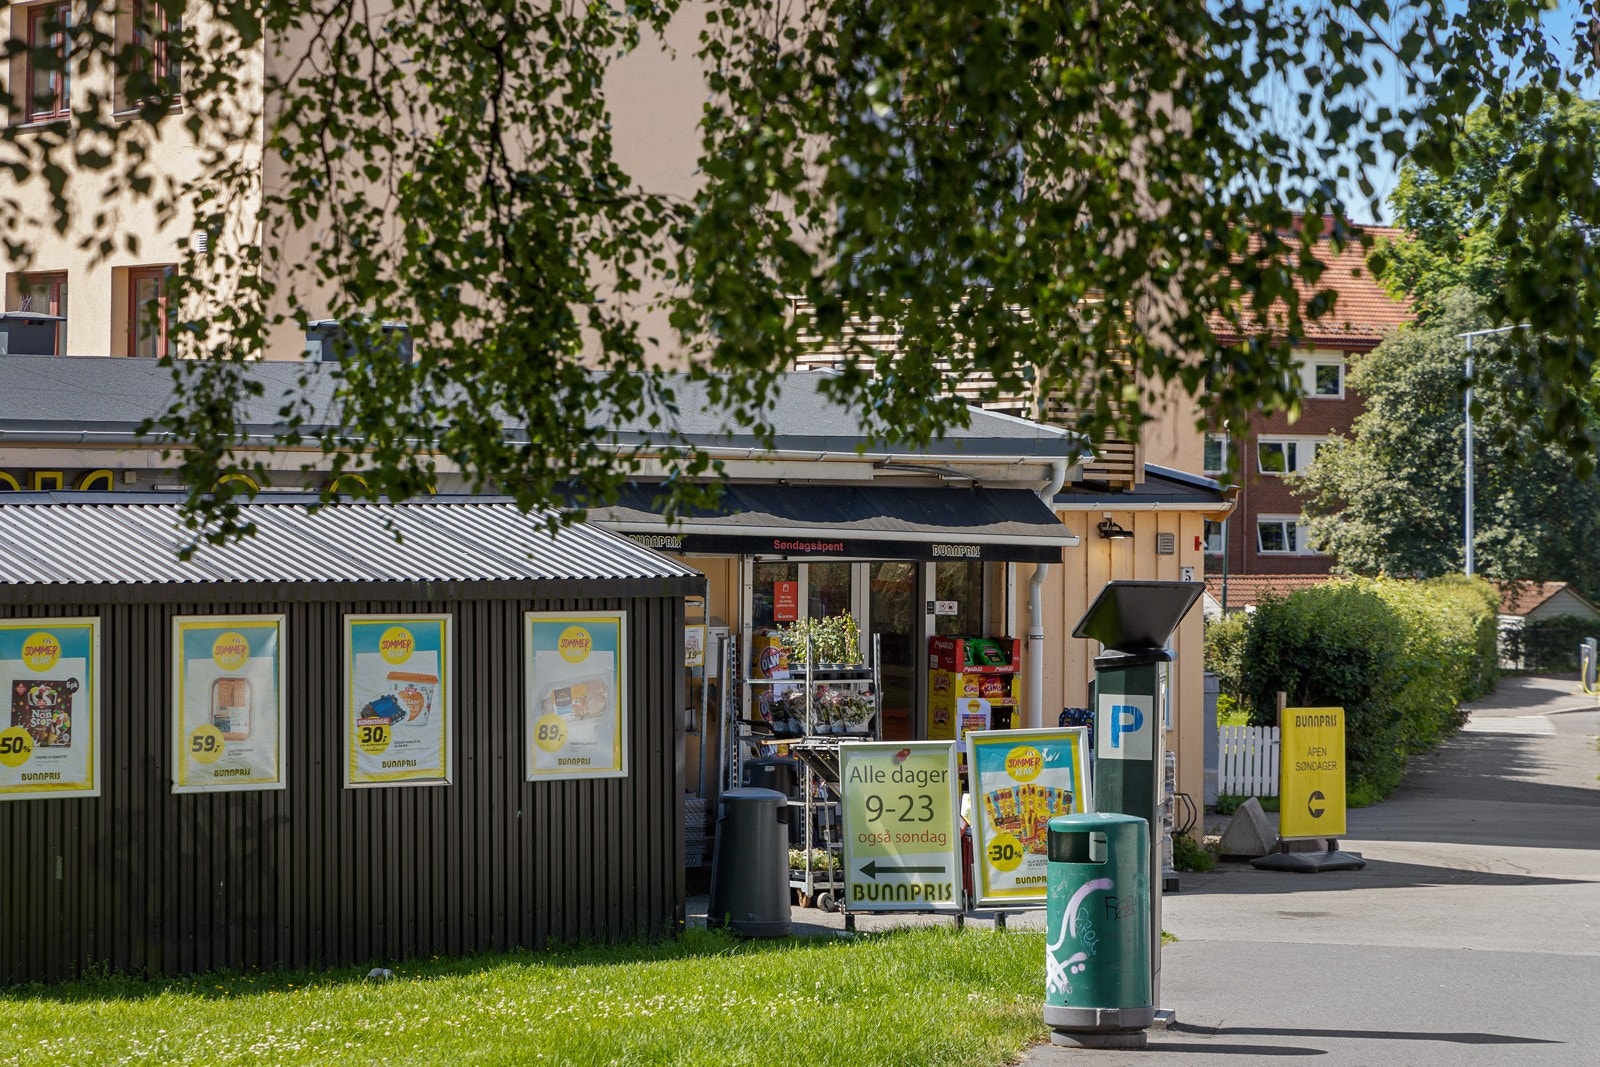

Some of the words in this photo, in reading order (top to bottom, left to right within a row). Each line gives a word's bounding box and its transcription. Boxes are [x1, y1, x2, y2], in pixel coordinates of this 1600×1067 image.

[773, 539, 844, 552] Søndagsåpent
[932, 544, 980, 557] BUNNPRIS
[1184, 569, 1192, 582] 5
[215, 644, 246, 658] SOMMER
[382, 639, 412, 652] SOMMER
[561, 638, 590, 651] SOMMER
[24, 646, 58, 659] SOMMER
[1111, 705, 1143, 748] P
[1295, 715, 1337, 727] BUNNPRIS
[1307, 747, 1327, 757] ÅPEN
[382, 760, 417, 768] BUNNPRIS
[558, 758, 591, 766] BUNNPRIS
[1008, 758, 1040, 770] SOMMER
[1295, 761, 1337, 771] SØNDAGER
[22, 772, 61, 781] BUNNPRIS
[214, 768, 251, 777] BUNNPRIS
[849, 765, 886, 783] Alle
[892, 765, 948, 788] dager
[865, 794, 935, 822] 9-23
[858, 830, 891, 846] også
[895, 830, 947, 846] søndag
[989, 844, 1022, 861] -30%
[1016, 876, 1047, 885] BUNNPR
[853, 883, 952, 902] BUNNPRIS
